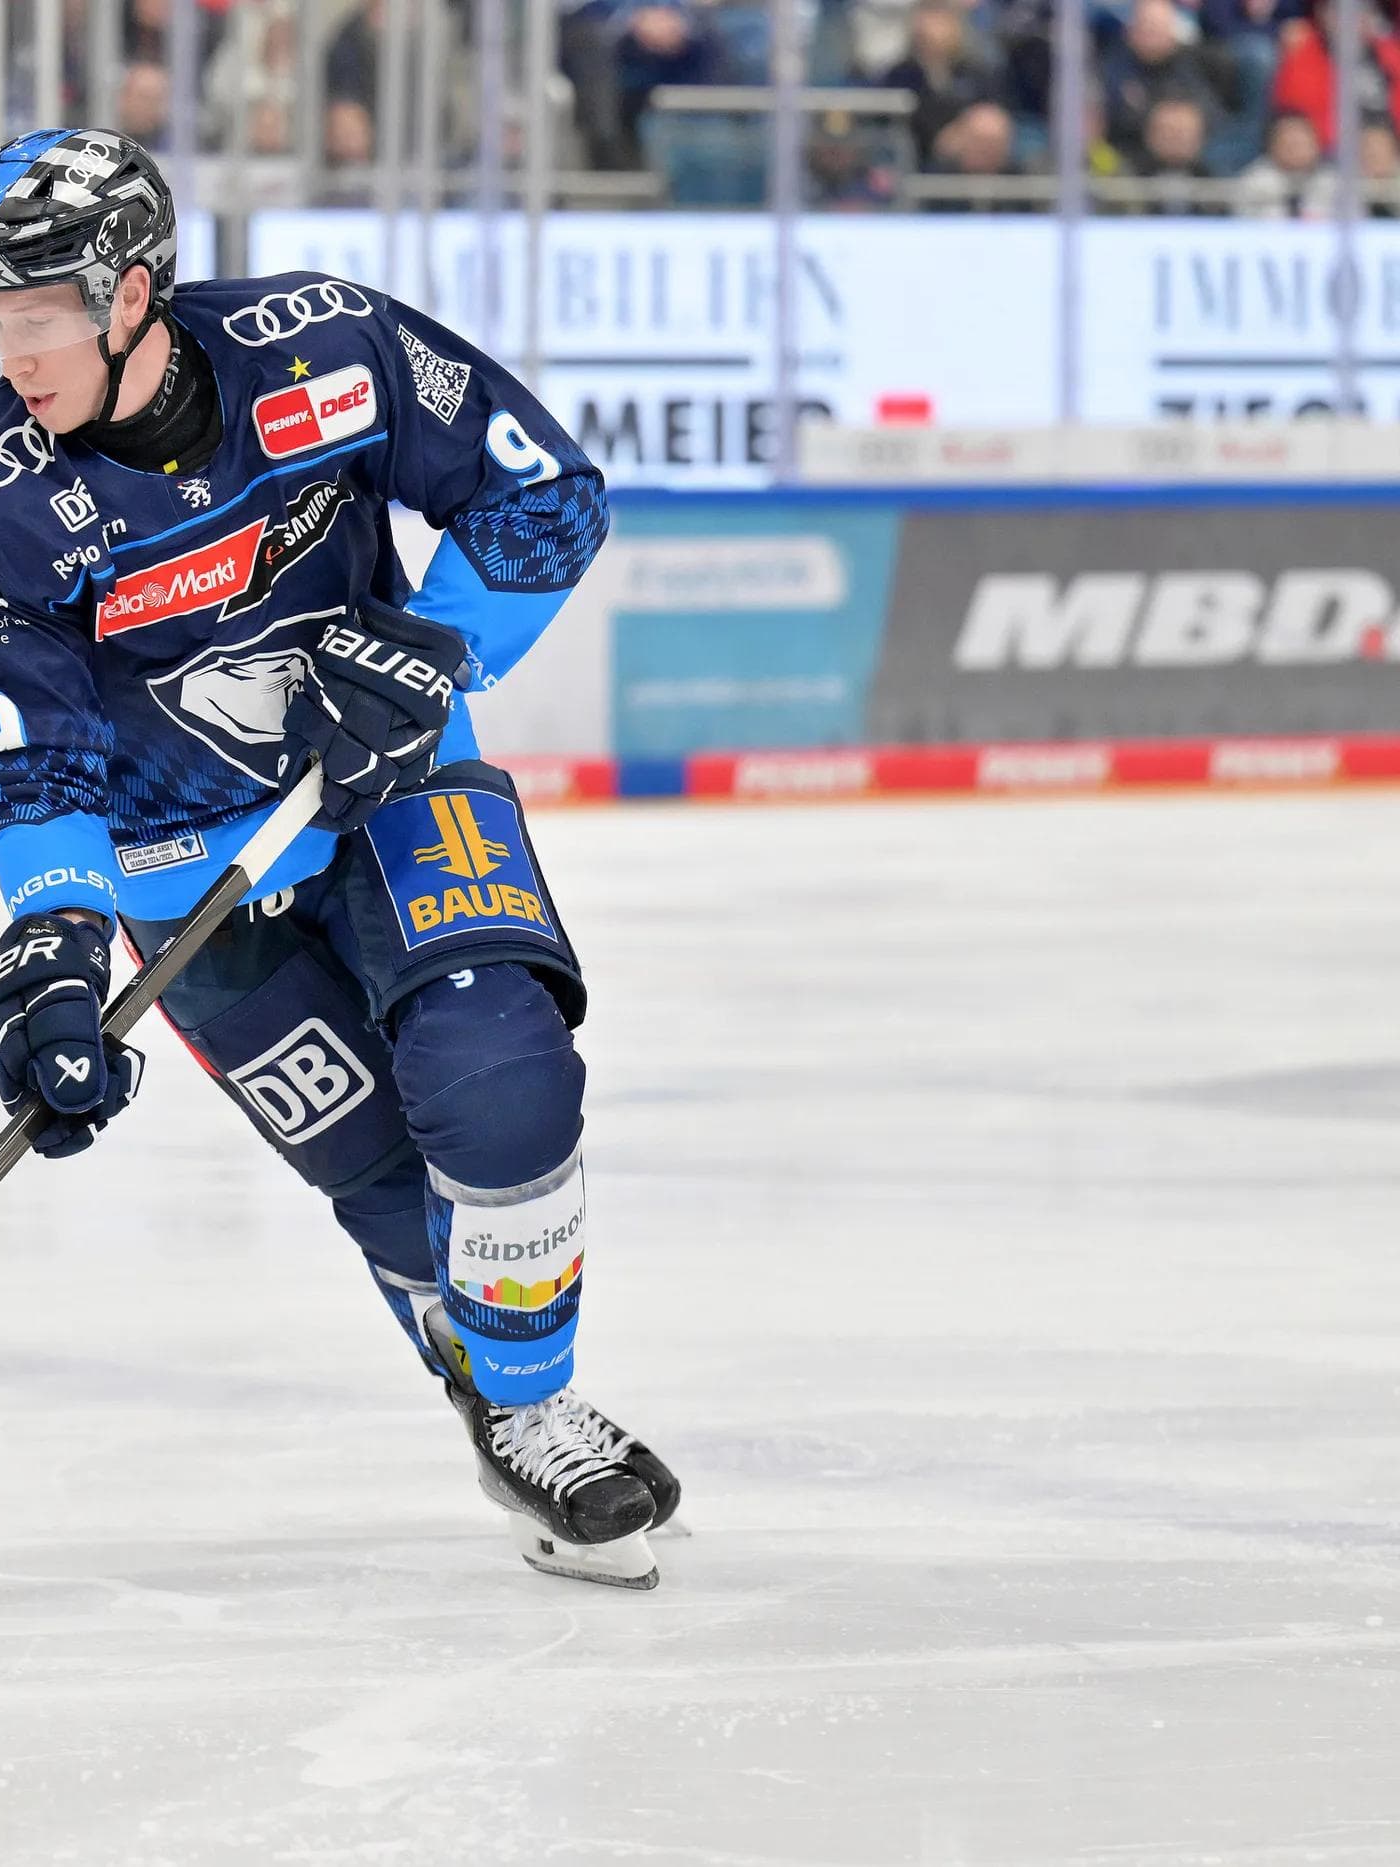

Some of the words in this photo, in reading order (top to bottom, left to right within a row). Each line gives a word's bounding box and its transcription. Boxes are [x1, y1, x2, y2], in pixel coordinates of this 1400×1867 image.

[485, 410, 562, 487] 9
[408, 884, 548, 933] BAUER
[239, 1038, 354, 1138] DB
